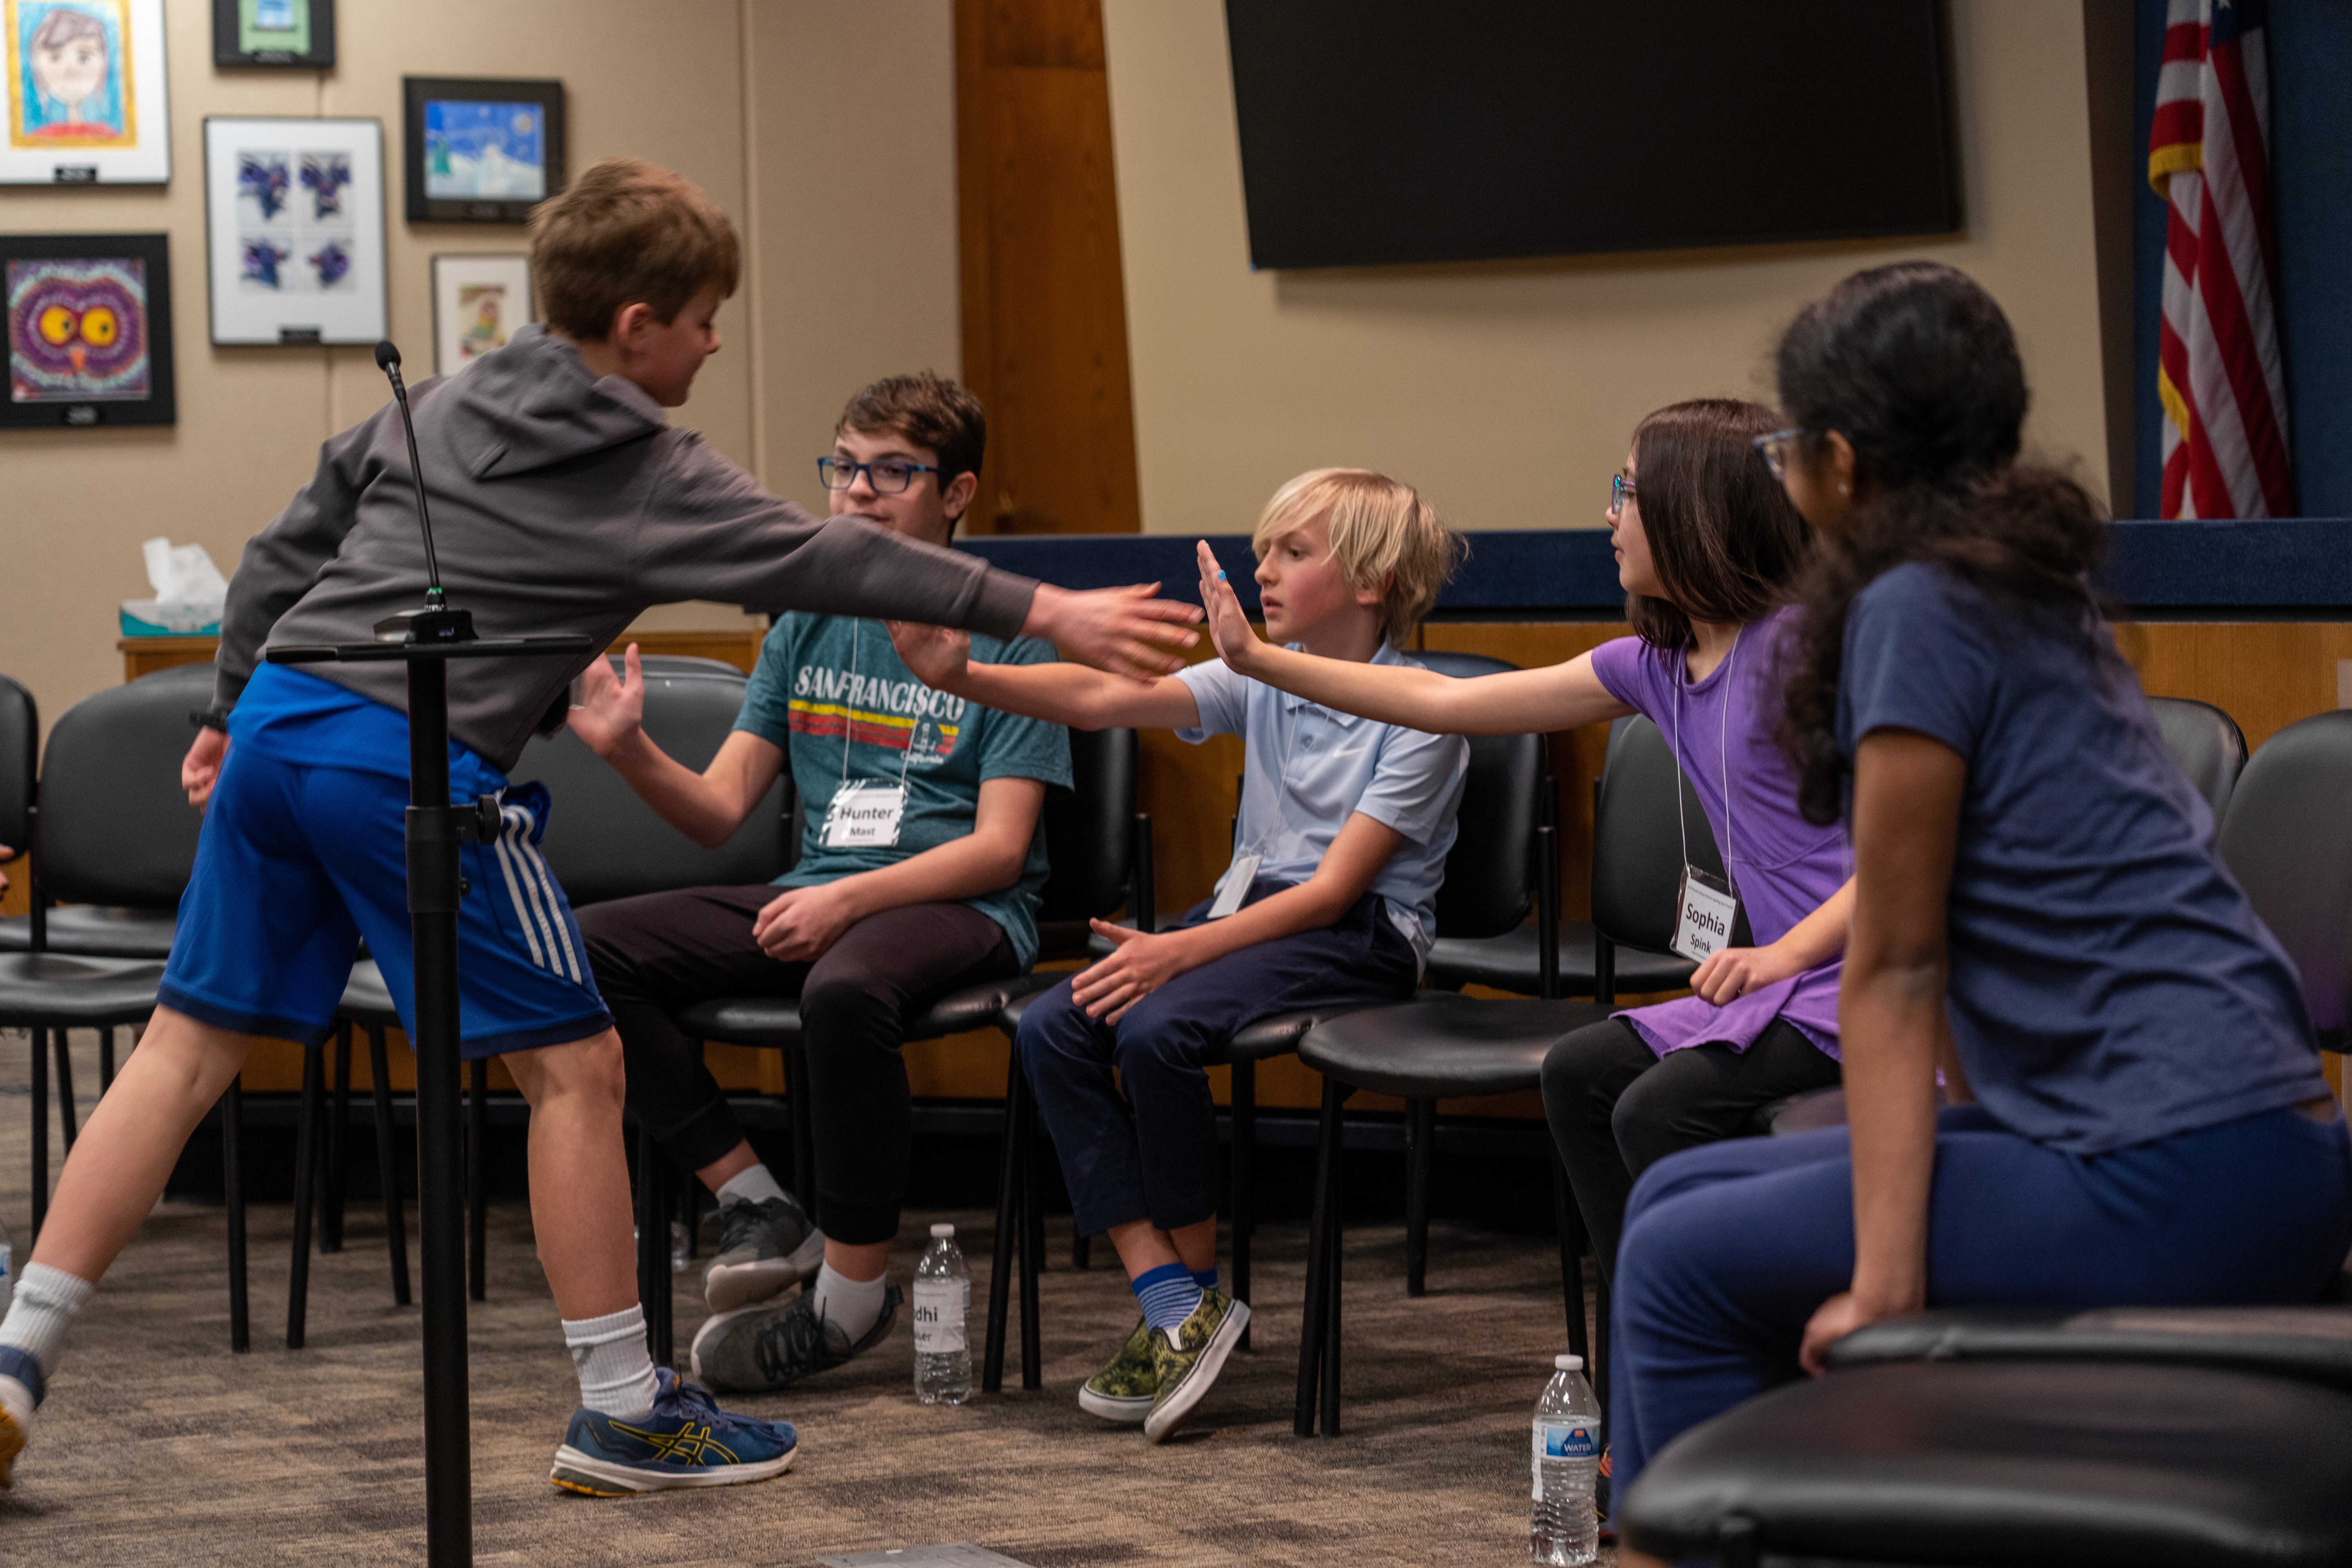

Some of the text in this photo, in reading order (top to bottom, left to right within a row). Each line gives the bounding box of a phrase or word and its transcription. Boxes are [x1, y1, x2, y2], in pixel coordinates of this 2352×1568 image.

[840, 807, 894, 820] Hunter
[850, 827, 875, 836] Mast
[1686, 903, 1725, 937] Sophia
[1690, 933, 1711, 955] Spink
[1564, 1443, 1591, 1452] WATER
